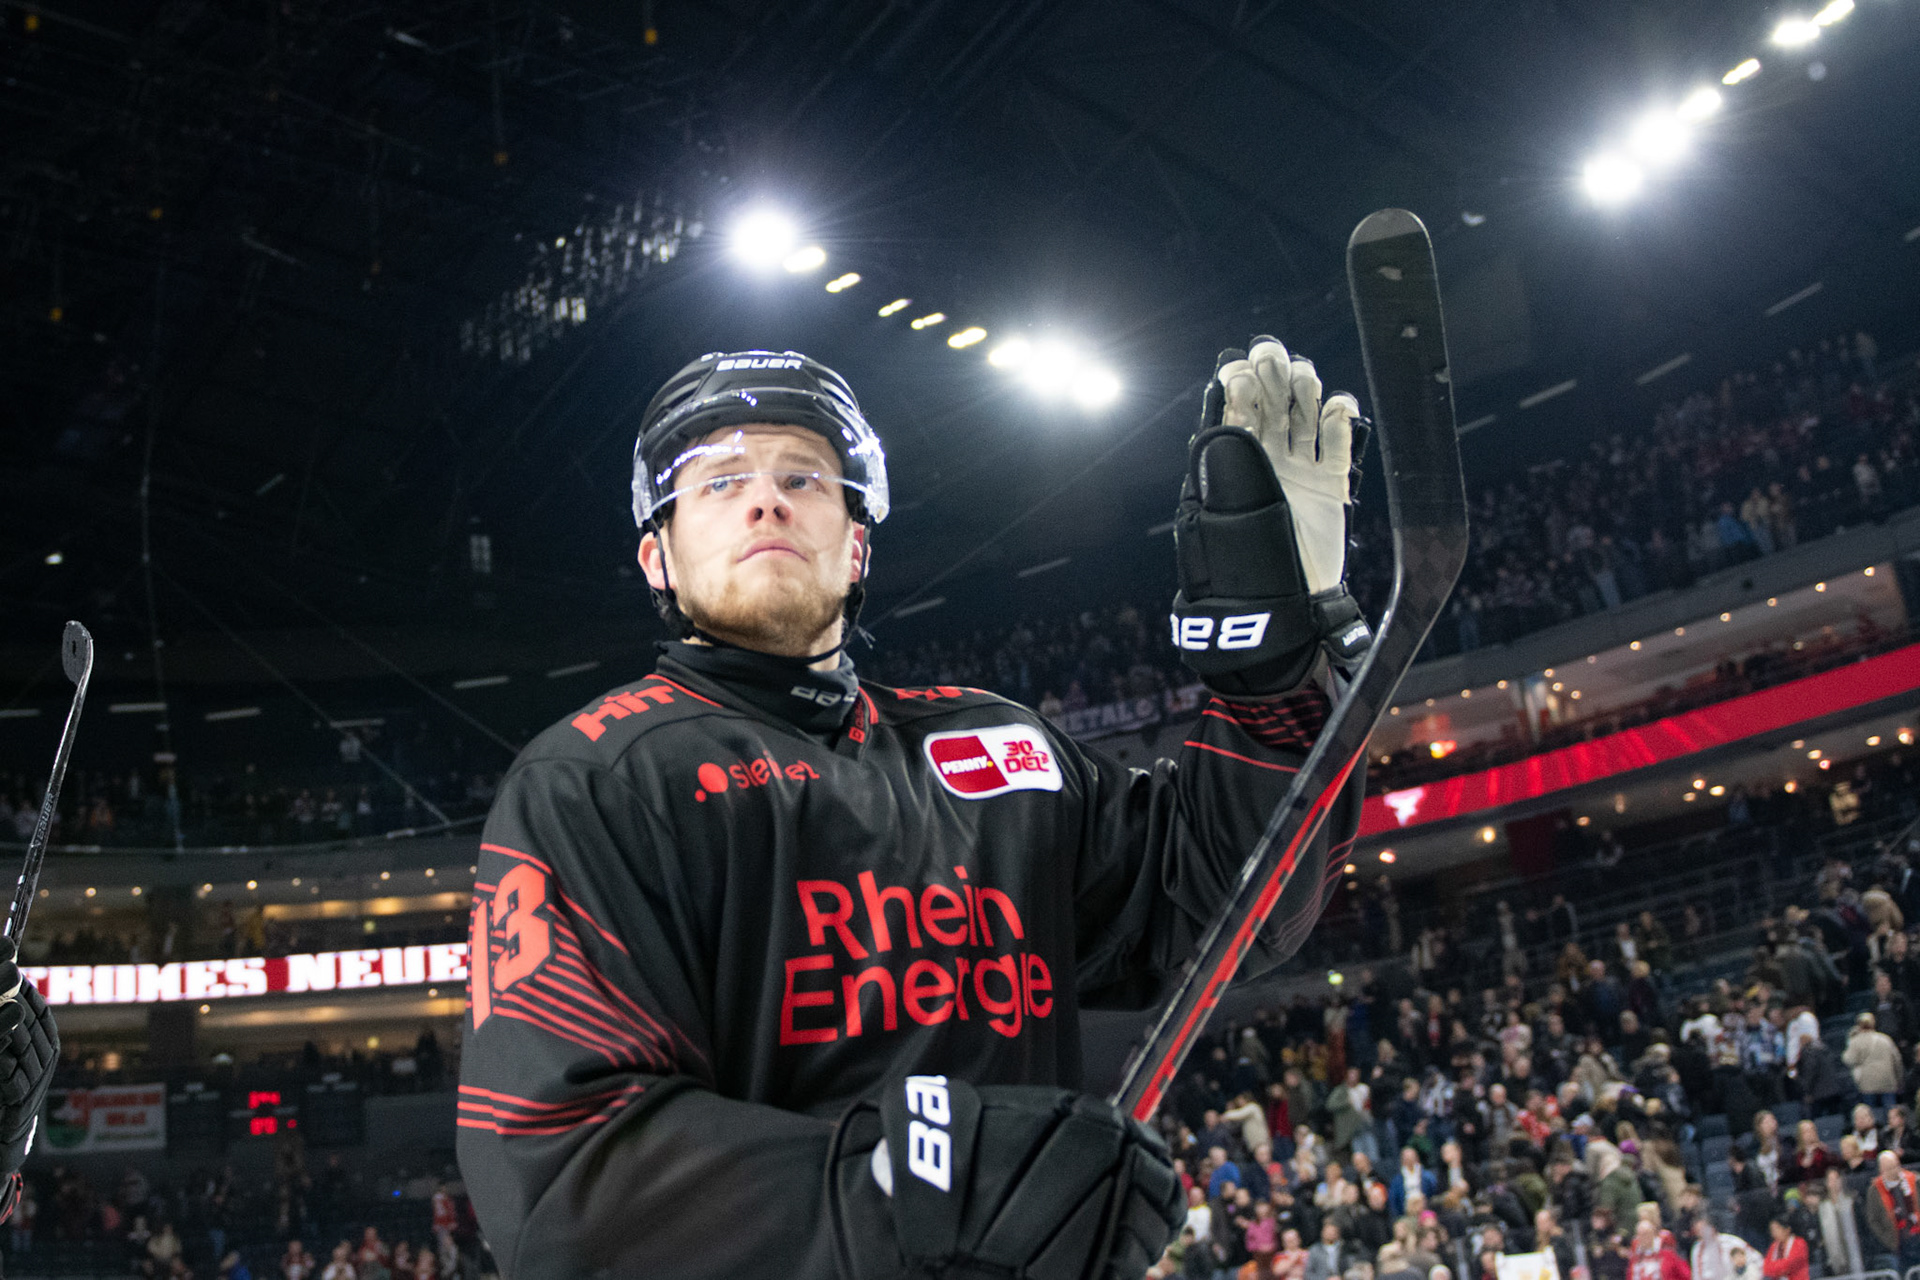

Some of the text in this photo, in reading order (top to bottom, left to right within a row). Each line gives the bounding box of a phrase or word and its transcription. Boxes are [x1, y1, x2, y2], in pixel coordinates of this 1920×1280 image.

[716, 358, 802, 372] BAUER
[1003, 740, 1034, 757] 30
[470, 862, 551, 1031] 13
[796, 865, 1025, 960] Rhein
[285, 943, 467, 993] NEUE
[780, 951, 1054, 1046] Energie
